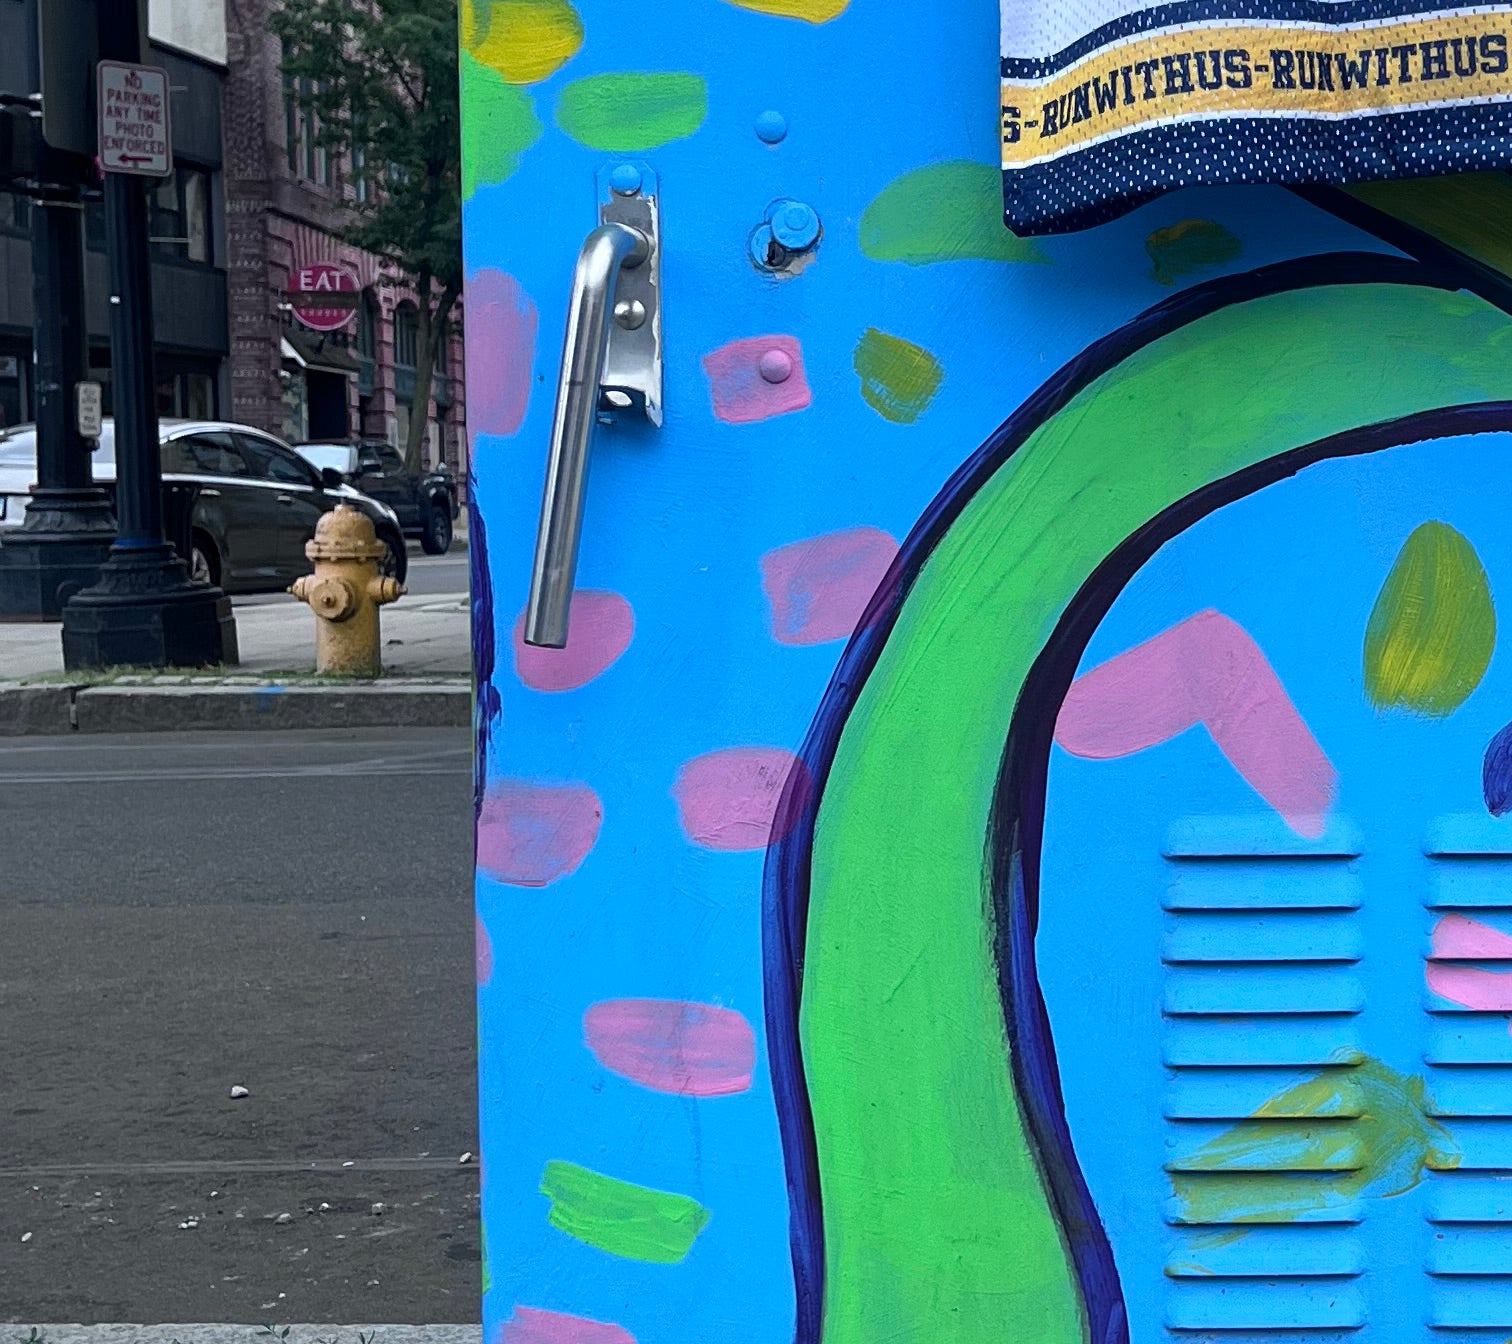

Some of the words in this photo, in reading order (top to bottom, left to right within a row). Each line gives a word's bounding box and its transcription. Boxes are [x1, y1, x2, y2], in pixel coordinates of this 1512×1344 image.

[124, 74, 143, 89] NO
[106, 87, 162, 108] PARKING
[106, 105, 130, 120] ANY
[138, 107, 162, 125] TIME
[115, 120, 154, 139] PHOTO
[103, 136, 165, 156] ENFORCED
[300, 269, 343, 292] EAT
